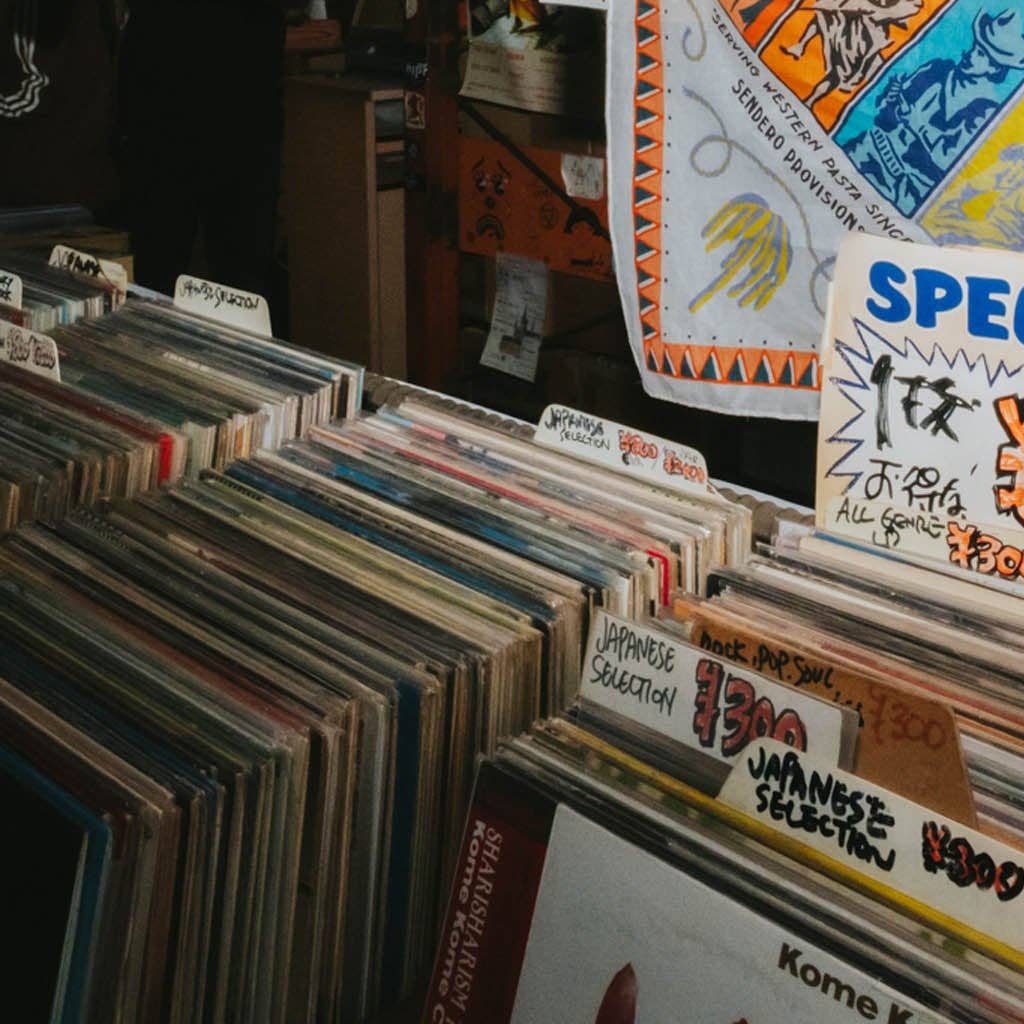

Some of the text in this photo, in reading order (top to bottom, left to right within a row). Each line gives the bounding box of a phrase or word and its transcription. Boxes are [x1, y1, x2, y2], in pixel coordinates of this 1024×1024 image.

[731, 78, 785, 151] SENDERO
[762, 81, 824, 152] WESTERN
[822, 157, 863, 201] PASTA
[559, 429, 611, 451] SELECTION
[836, 497, 875, 523] ALL
[590, 654, 678, 717] SELECTION
[595, 617, 676, 674] JAPANESE
[692, 659, 808, 758] ¥300
[747, 746, 896, 839] JAPANESE
[755, 782, 897, 873] SELECTION
[458, 819, 487, 905] Kome
[438, 910, 468, 996] Kome
[451, 826, 503, 1012] SHARISHARISM
[777, 942, 879, 1021] Kome
